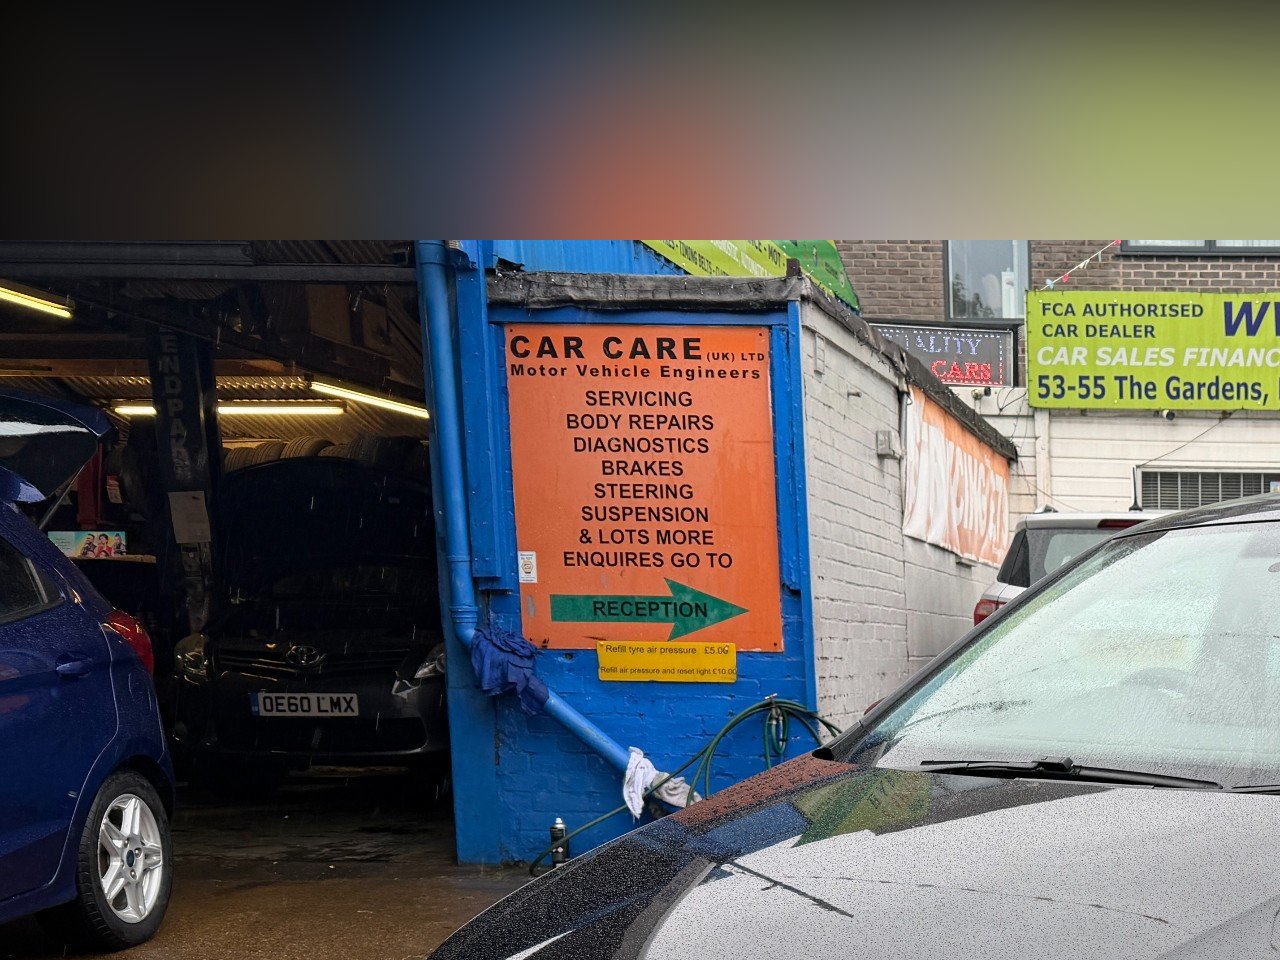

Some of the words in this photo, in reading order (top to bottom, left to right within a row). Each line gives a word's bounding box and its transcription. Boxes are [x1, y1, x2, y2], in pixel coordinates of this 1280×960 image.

[1041, 302, 1079, 318] FCA
[1082, 302, 1204, 319] AUTHORISED
[1041, 324, 1083, 339] CAR
[1085, 324, 1156, 339] DEALER
[510, 335, 585, 359] CAR
[602, 336, 702, 361] CARE
[706, 351, 736, 364] (UK)
[741, 352, 766, 362] LTD
[1036, 346, 1091, 367] CAR
[1094, 346, 1176, 367] SALES
[510, 363, 568, 377] Motor
[576, 363, 650, 378] Vehicle
[660, 365, 761, 381] Engineers
[930, 359, 992, 380] CARS
[585, 390, 693, 407] SERVICING
[1036, 375, 1106, 400] 53-55
[1113, 376, 1157, 401] The
[1165, 376, 1270, 406] Gardens,
[566, 413, 622, 430] BODY
[628, 414, 714, 431] REPAIRS
[573, 437, 710, 454] DIAGNOSTICS
[601, 460, 684, 476] BRAKES
[594, 483, 694, 499] STEERING
[581, 505, 709, 522] SUSPENSION
[579, 528, 593, 544] &
[598, 529, 650, 545] LOTS
[656, 530, 715, 545] MORE
[563, 551, 665, 568] ENQUIRES
[670, 552, 701, 568] GO
[706, 553, 733, 569] TO
[592, 600, 708, 618] RECEPTION
[605, 645, 627, 653] Refill
[628, 645, 645, 656] tyre
[646, 645, 658, 654] air
[660, 646, 697, 655] pressure
[600, 666, 618, 674] Refill
[662, 667, 675, 675] and
[696, 667, 711, 676] light
[262, 696, 312, 713] OE60
[317, 696, 356, 713] LMX
